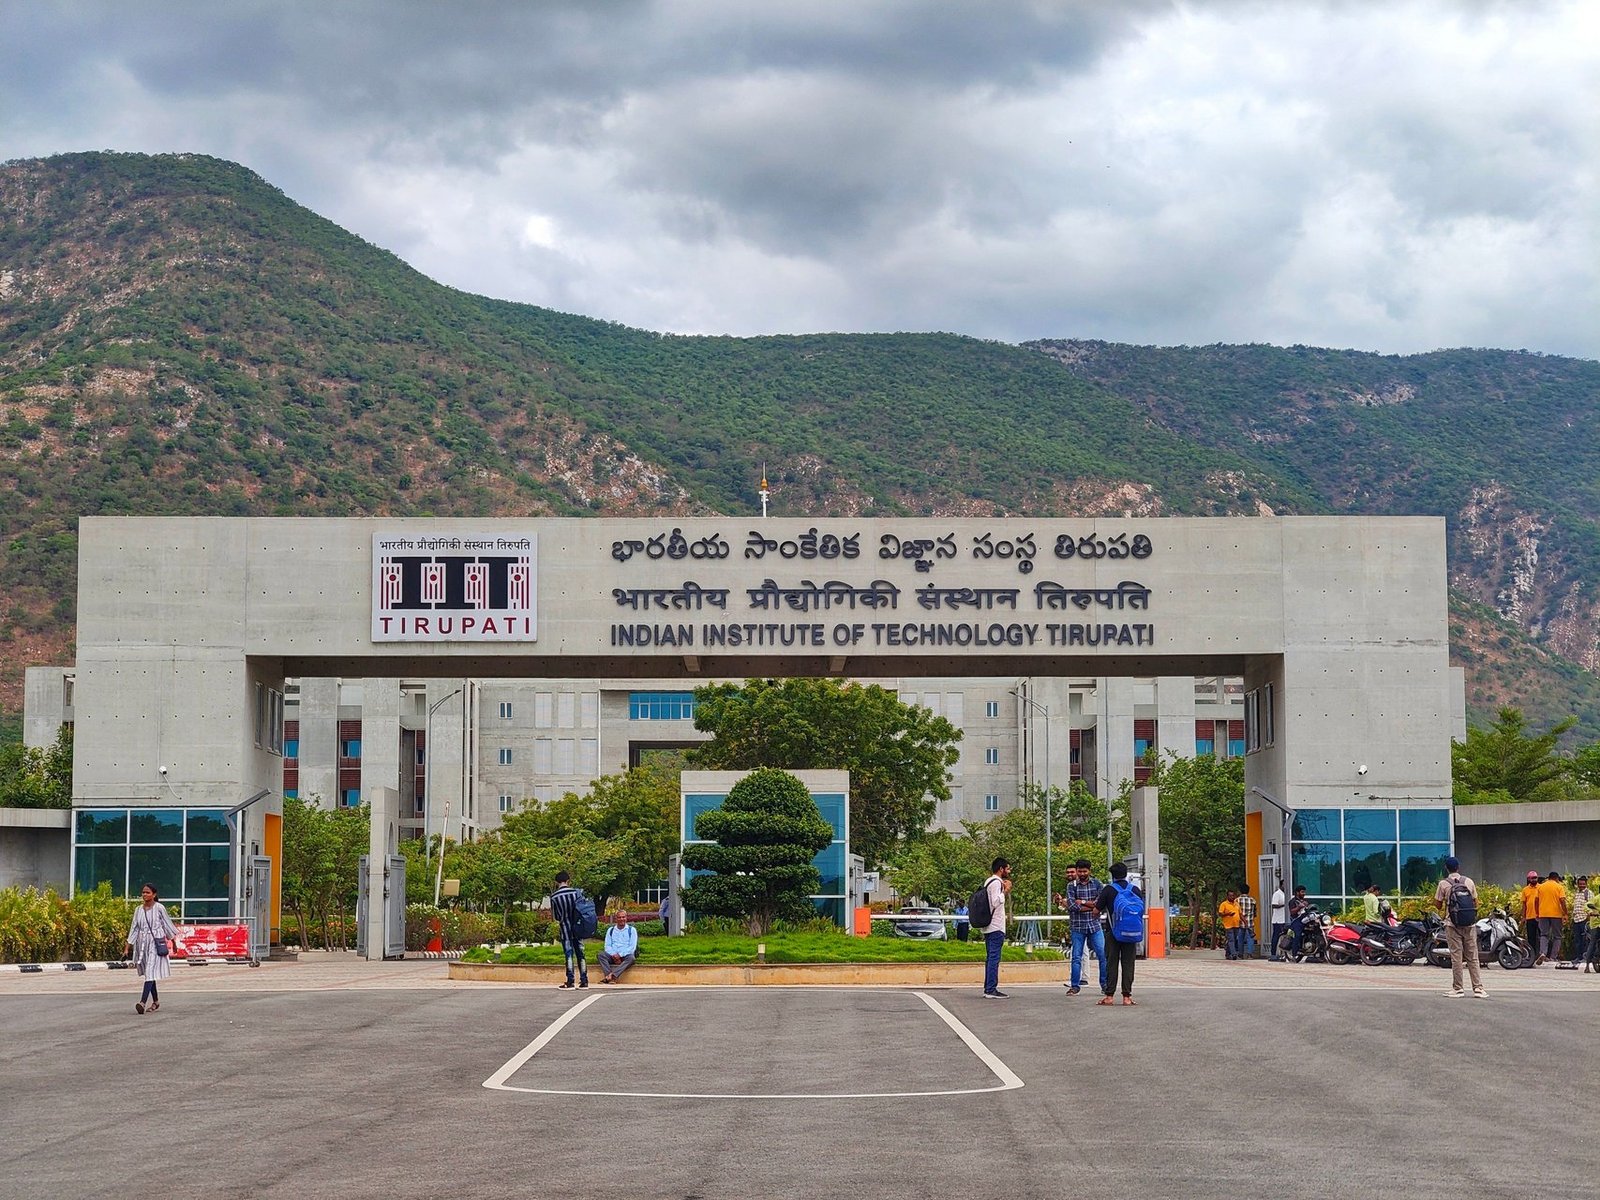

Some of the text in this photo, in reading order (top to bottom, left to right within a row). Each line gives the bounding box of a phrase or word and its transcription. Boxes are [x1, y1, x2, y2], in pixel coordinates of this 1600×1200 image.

[380, 537, 530, 551] भारतीय प्रौद्योगिकी संस्थान तिरुपति
[611, 528, 1153, 574] భారతీయ సాంకేతిక విజ్ఞాన సంస్థ తిరుపతి
[391, 556, 519, 609] IIT
[611, 579, 1152, 612] भारतीय प्रौद्योगिकी संस्थान तिरुपति
[380, 617, 530, 634] TIRUPATI
[611, 624, 1154, 646] INDIAN INSTITUTE OF TECHNOLOGY TIRUPATI
